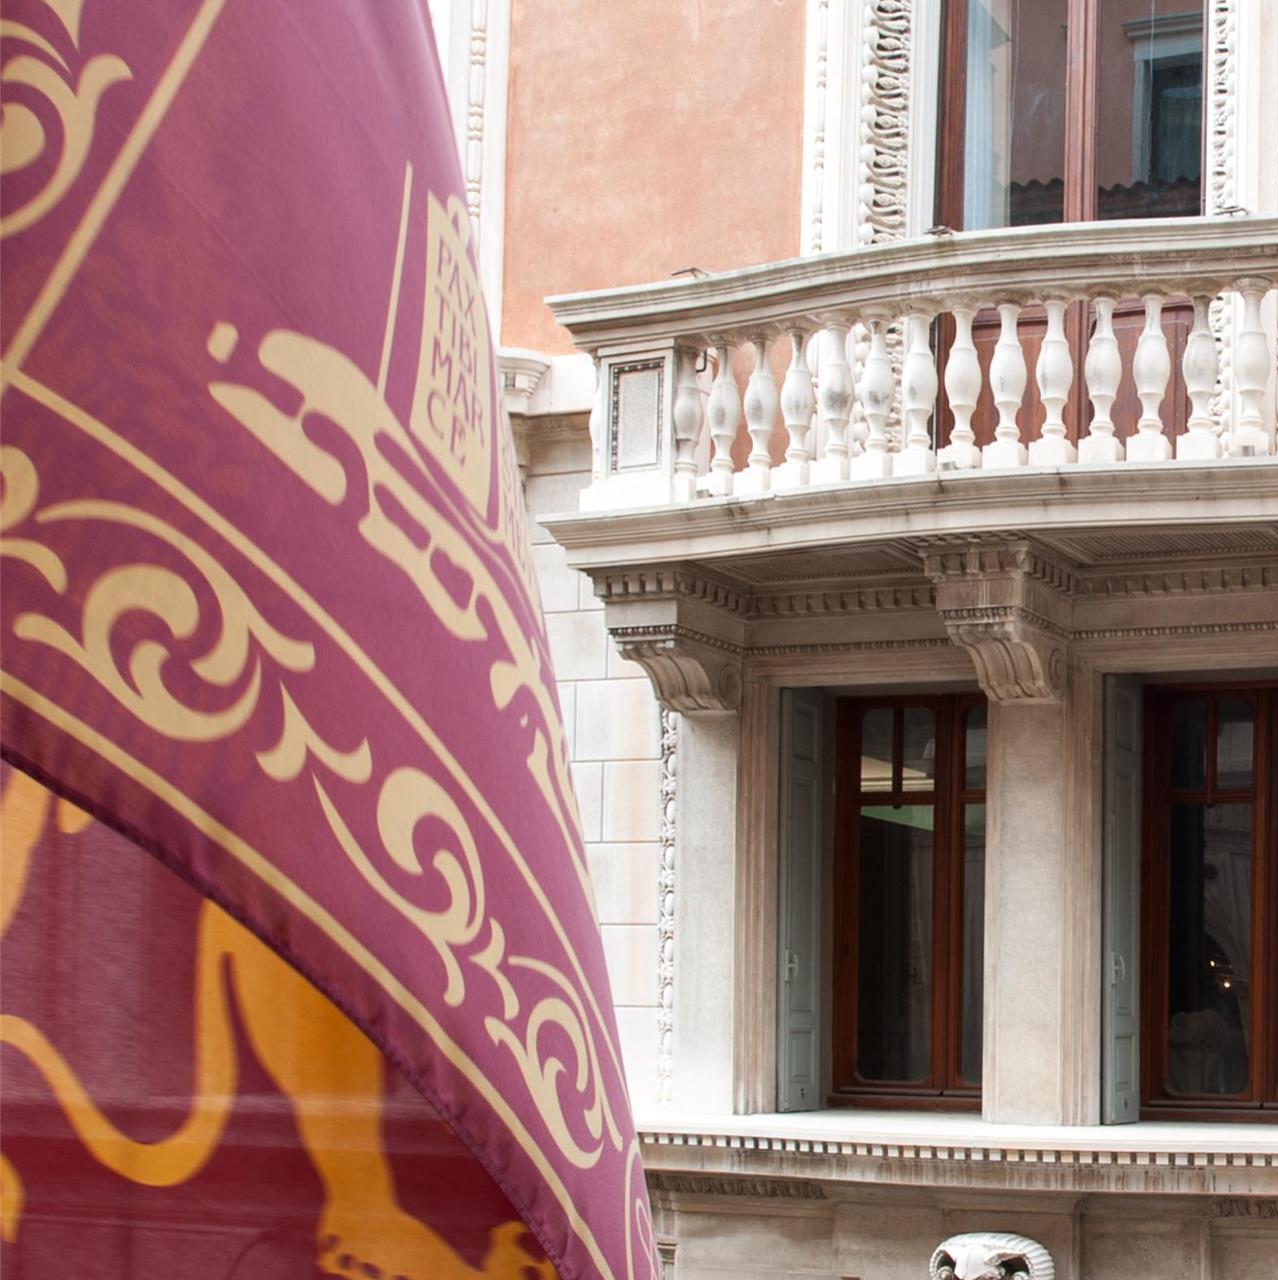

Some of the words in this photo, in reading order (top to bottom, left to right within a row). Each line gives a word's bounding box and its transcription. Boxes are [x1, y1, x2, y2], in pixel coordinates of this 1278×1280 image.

[434, 284, 478, 386] TIBI
[437, 234, 477, 338] PAX
[426, 386, 467, 468] CE
[431, 330, 485, 449] MAR
